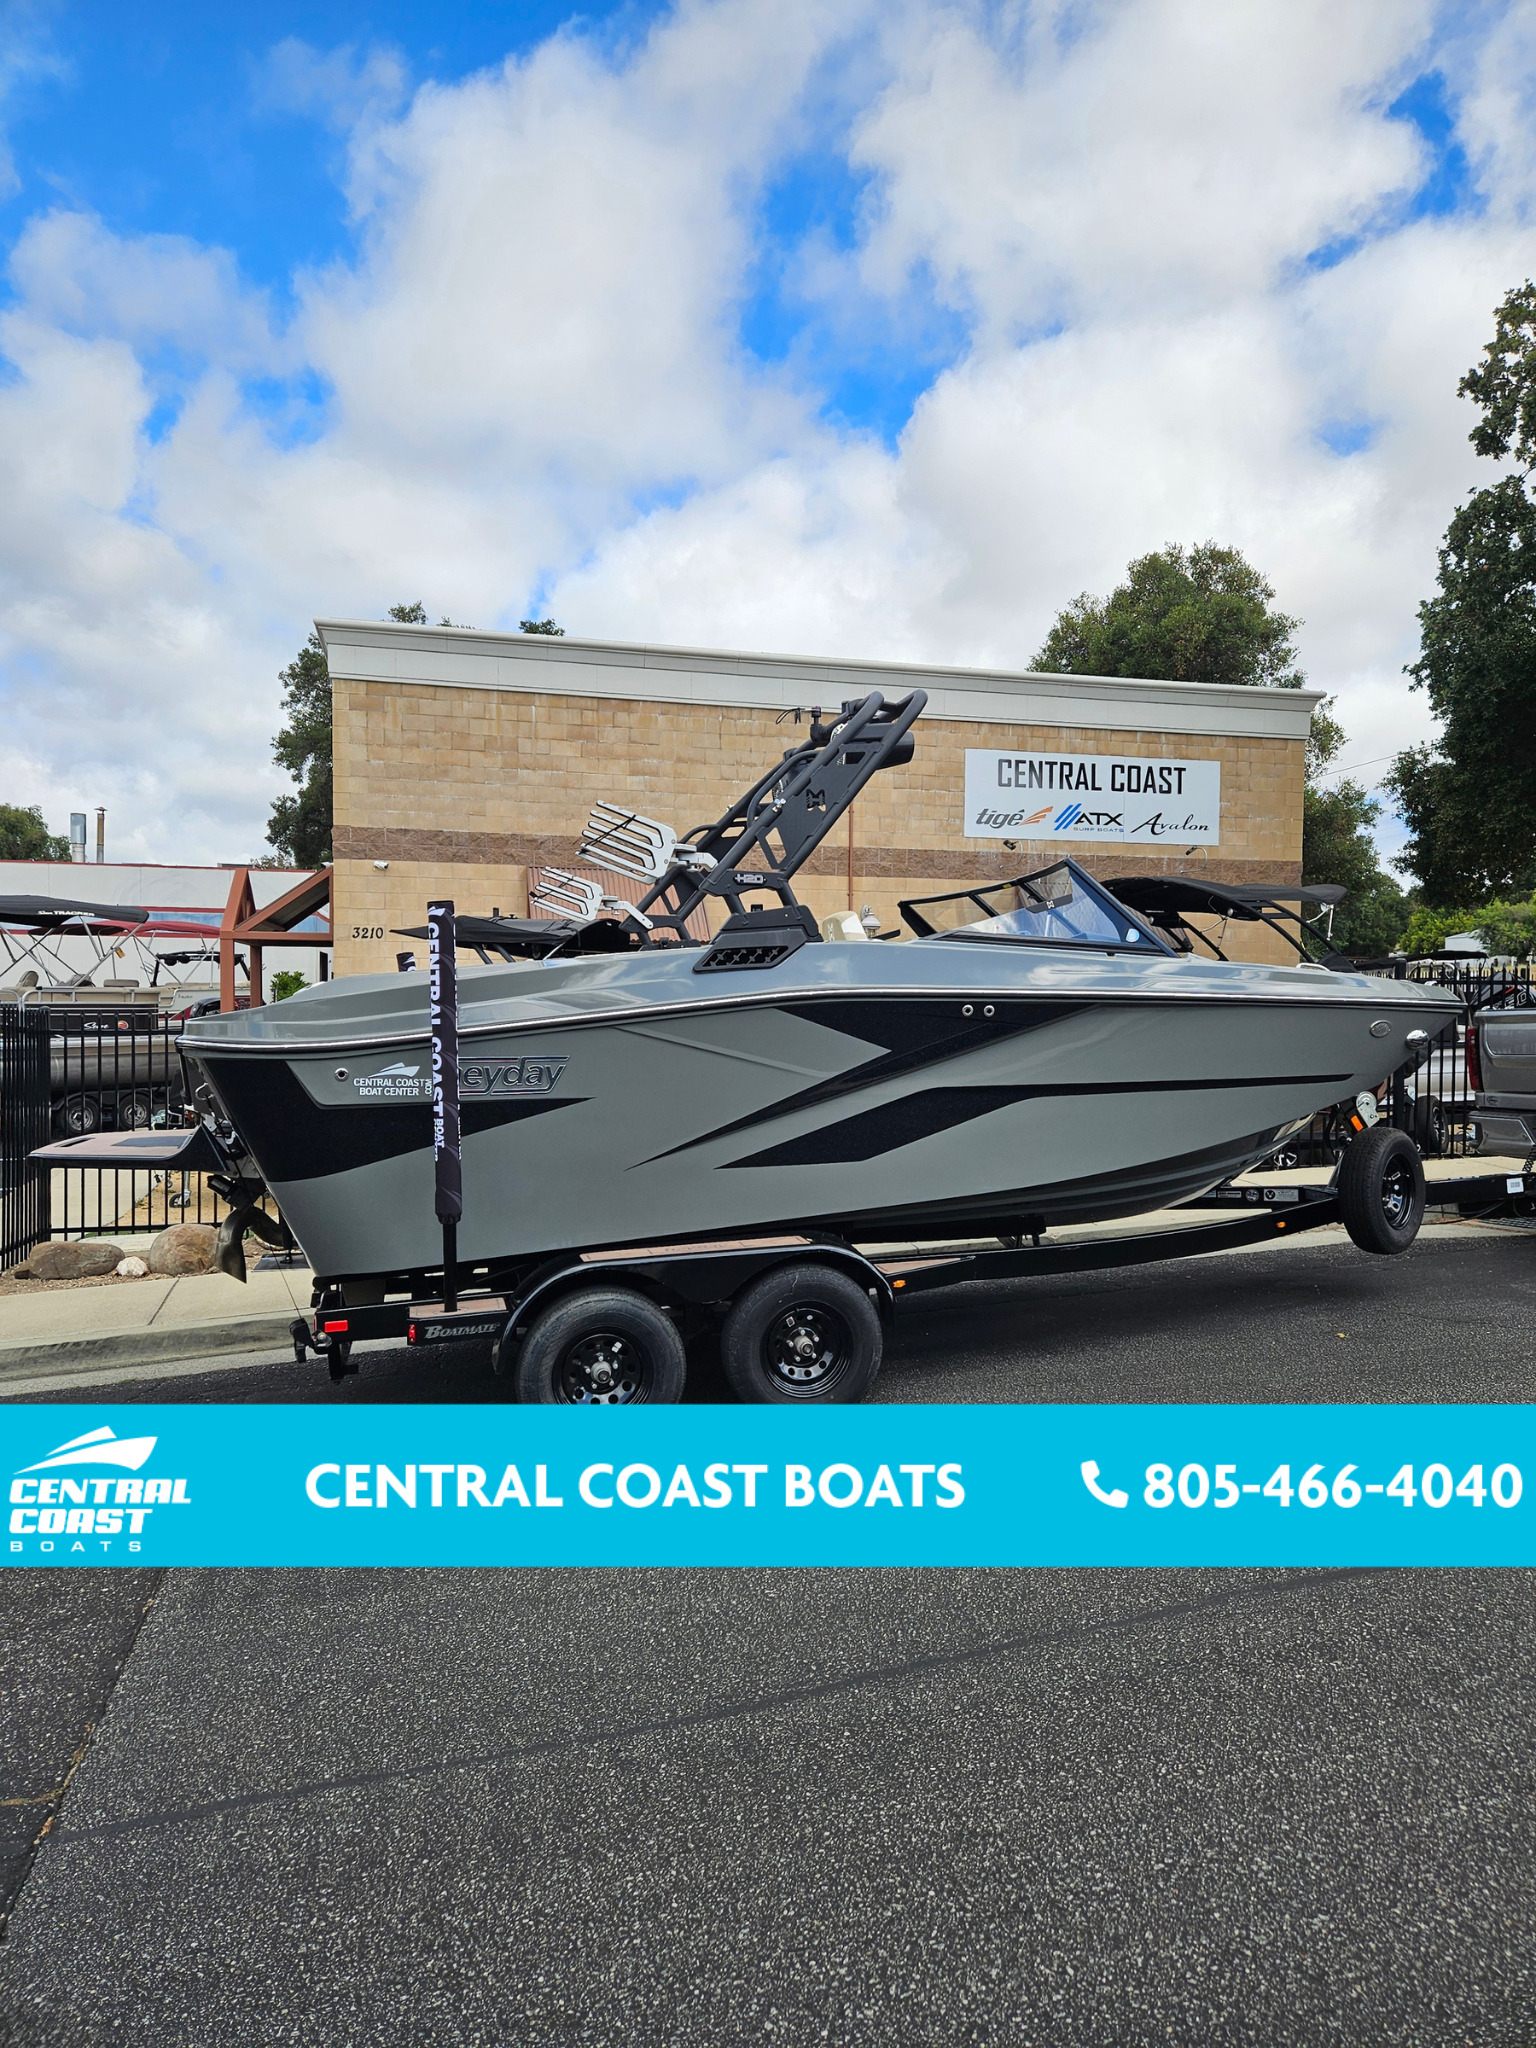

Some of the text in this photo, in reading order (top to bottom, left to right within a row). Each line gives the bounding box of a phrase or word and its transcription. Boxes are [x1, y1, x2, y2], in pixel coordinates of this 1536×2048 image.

[997, 758, 1186, 794] CENTRAL COAST
[975, 808, 1025, 829] tigé
[1075, 812, 1123, 826] ATX
[1130, 812, 1210, 835] Avalon
[352, 927, 384, 939] 3210
[353, 1078, 425, 1087] CENTRAL COAST
[458, 1057, 567, 1095] eyday
[360, 1087, 419, 1096] BOAT CENTER
[435, 1118, 445, 1148] BOAT
[424, 1323, 498, 1339] BOATMATE
